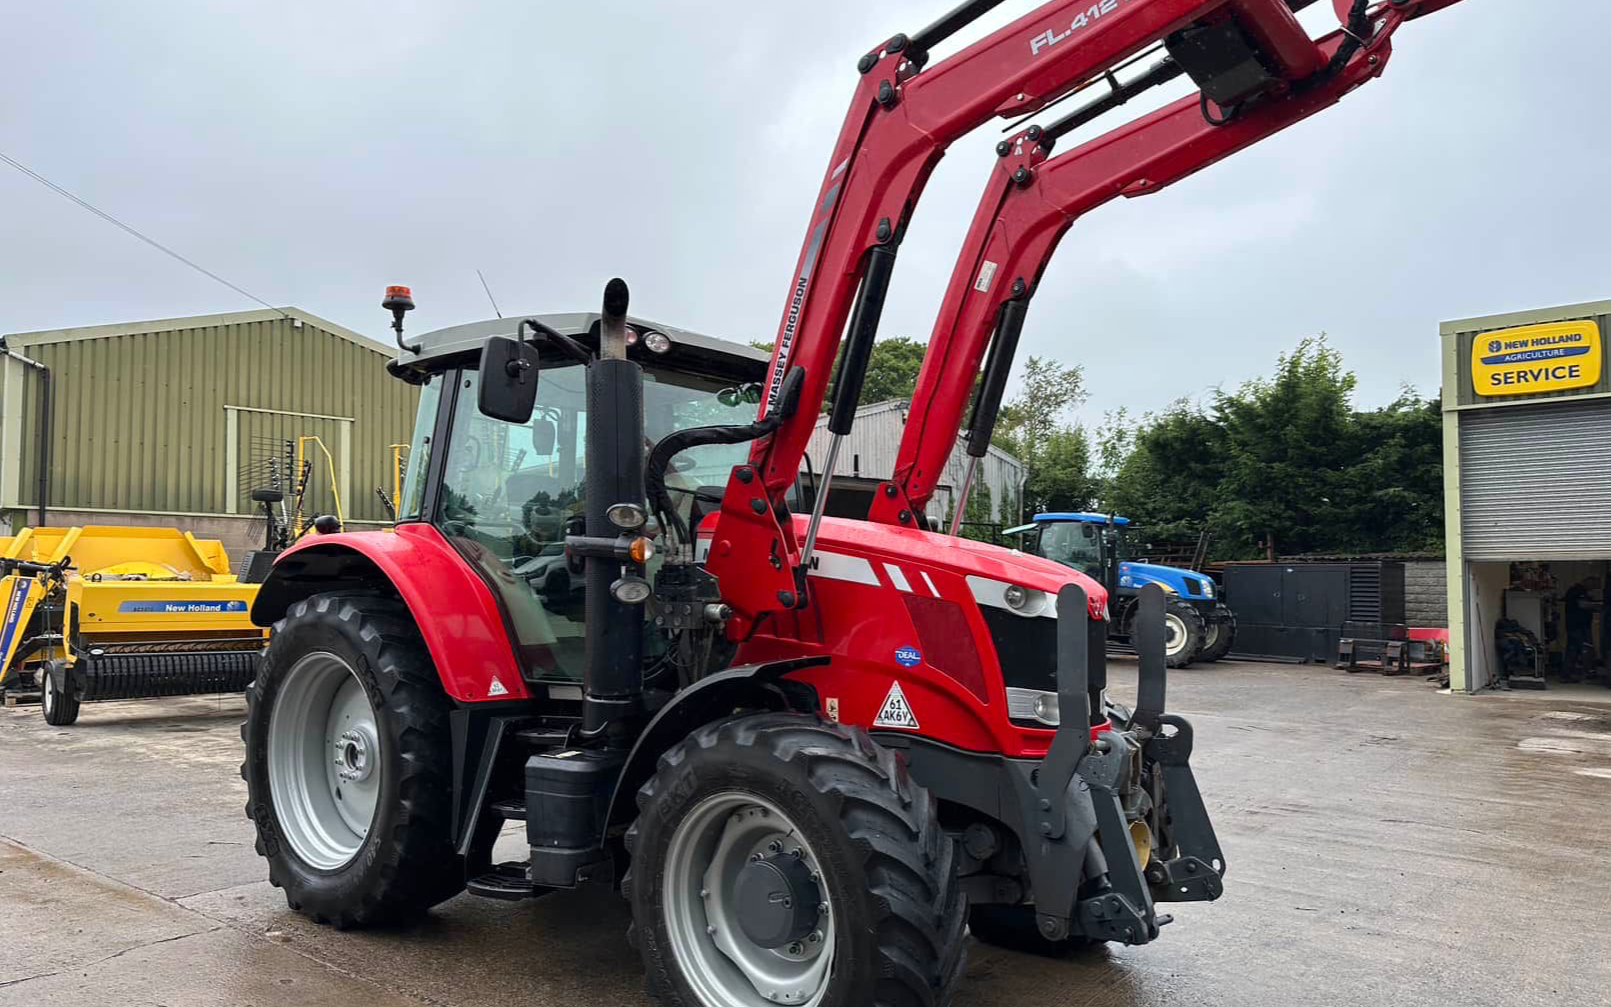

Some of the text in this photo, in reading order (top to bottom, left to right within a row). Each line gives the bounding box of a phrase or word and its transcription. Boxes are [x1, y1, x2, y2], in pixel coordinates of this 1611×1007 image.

[1030, 0, 1118, 55] FL.412
[768, 277, 808, 406] MASSEY FERGUSON
[1504, 333, 1582, 350] NEW HOLLAND
[1504, 348, 1565, 362] AGRICULTURE
[1491, 365, 1580, 386] SERVICE
[165, 604, 221, 612] New Holland
[889, 699, 902, 710] 61
